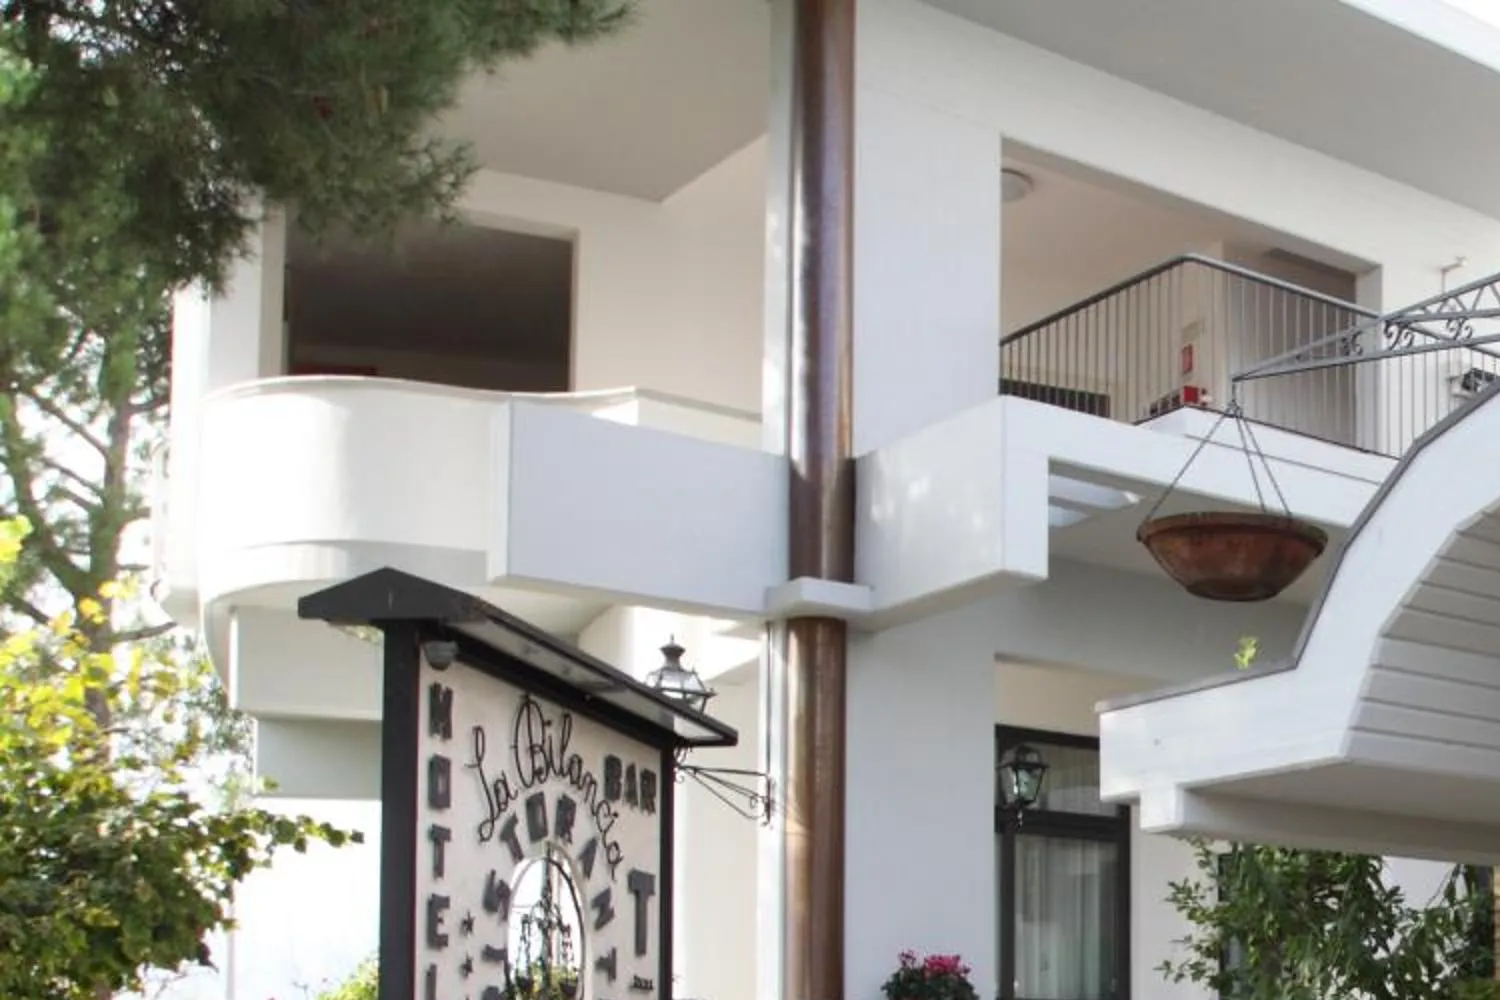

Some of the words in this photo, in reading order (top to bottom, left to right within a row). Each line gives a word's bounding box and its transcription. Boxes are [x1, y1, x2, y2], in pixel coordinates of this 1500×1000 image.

[464, 725, 518, 842] La
[510, 697, 624, 882] Bilancia
[603, 754, 657, 815] BAR
[627, 868, 656, 957] T
